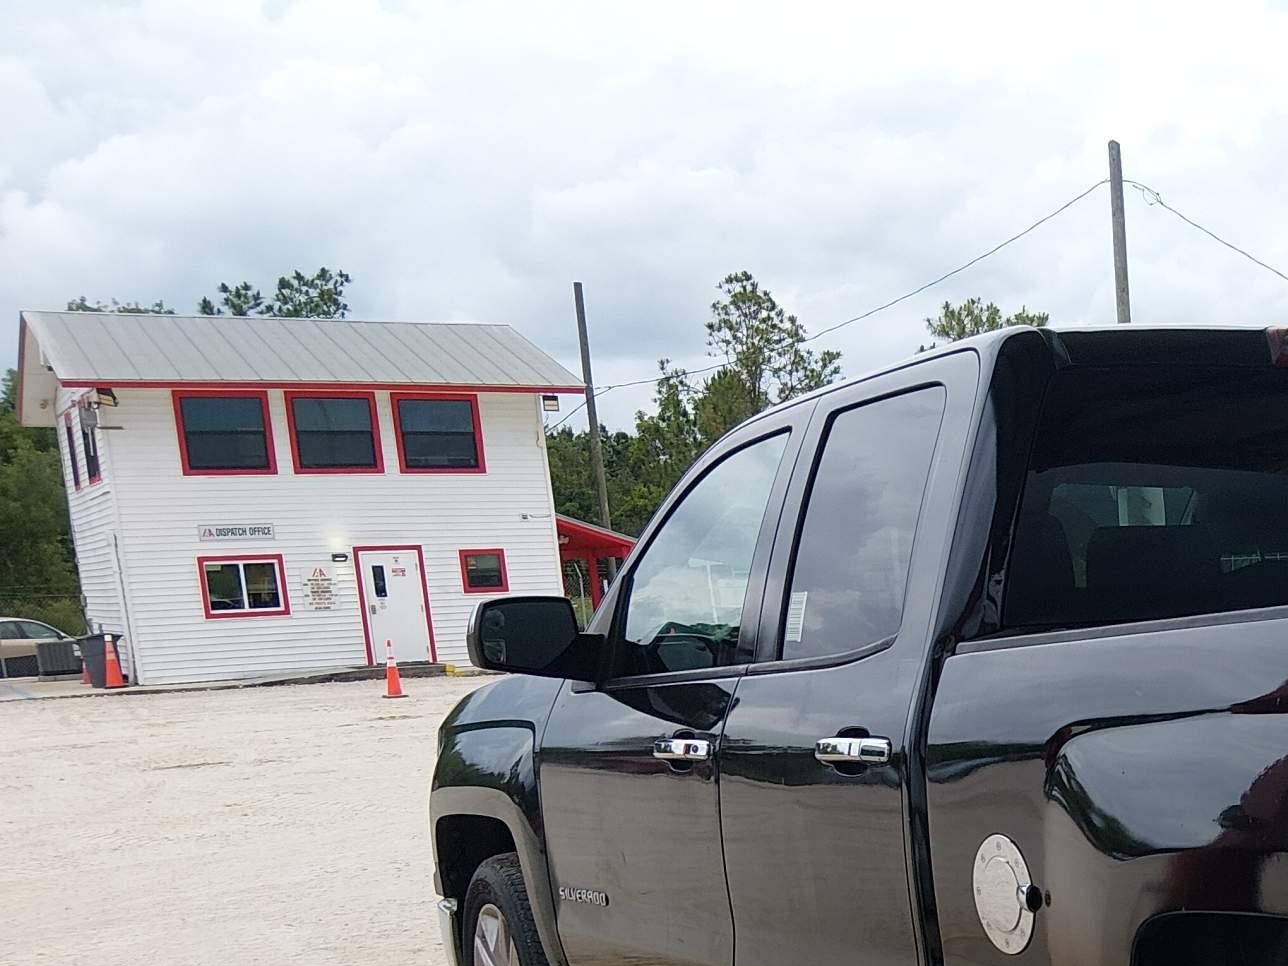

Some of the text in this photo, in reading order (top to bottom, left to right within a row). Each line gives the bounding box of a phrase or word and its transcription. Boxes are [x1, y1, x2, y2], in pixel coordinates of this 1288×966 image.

[215, 527, 247, 537] DISPATCH
[248, 526, 273, 537] OFFICE
[559, 886, 607, 906] SILVERADO
